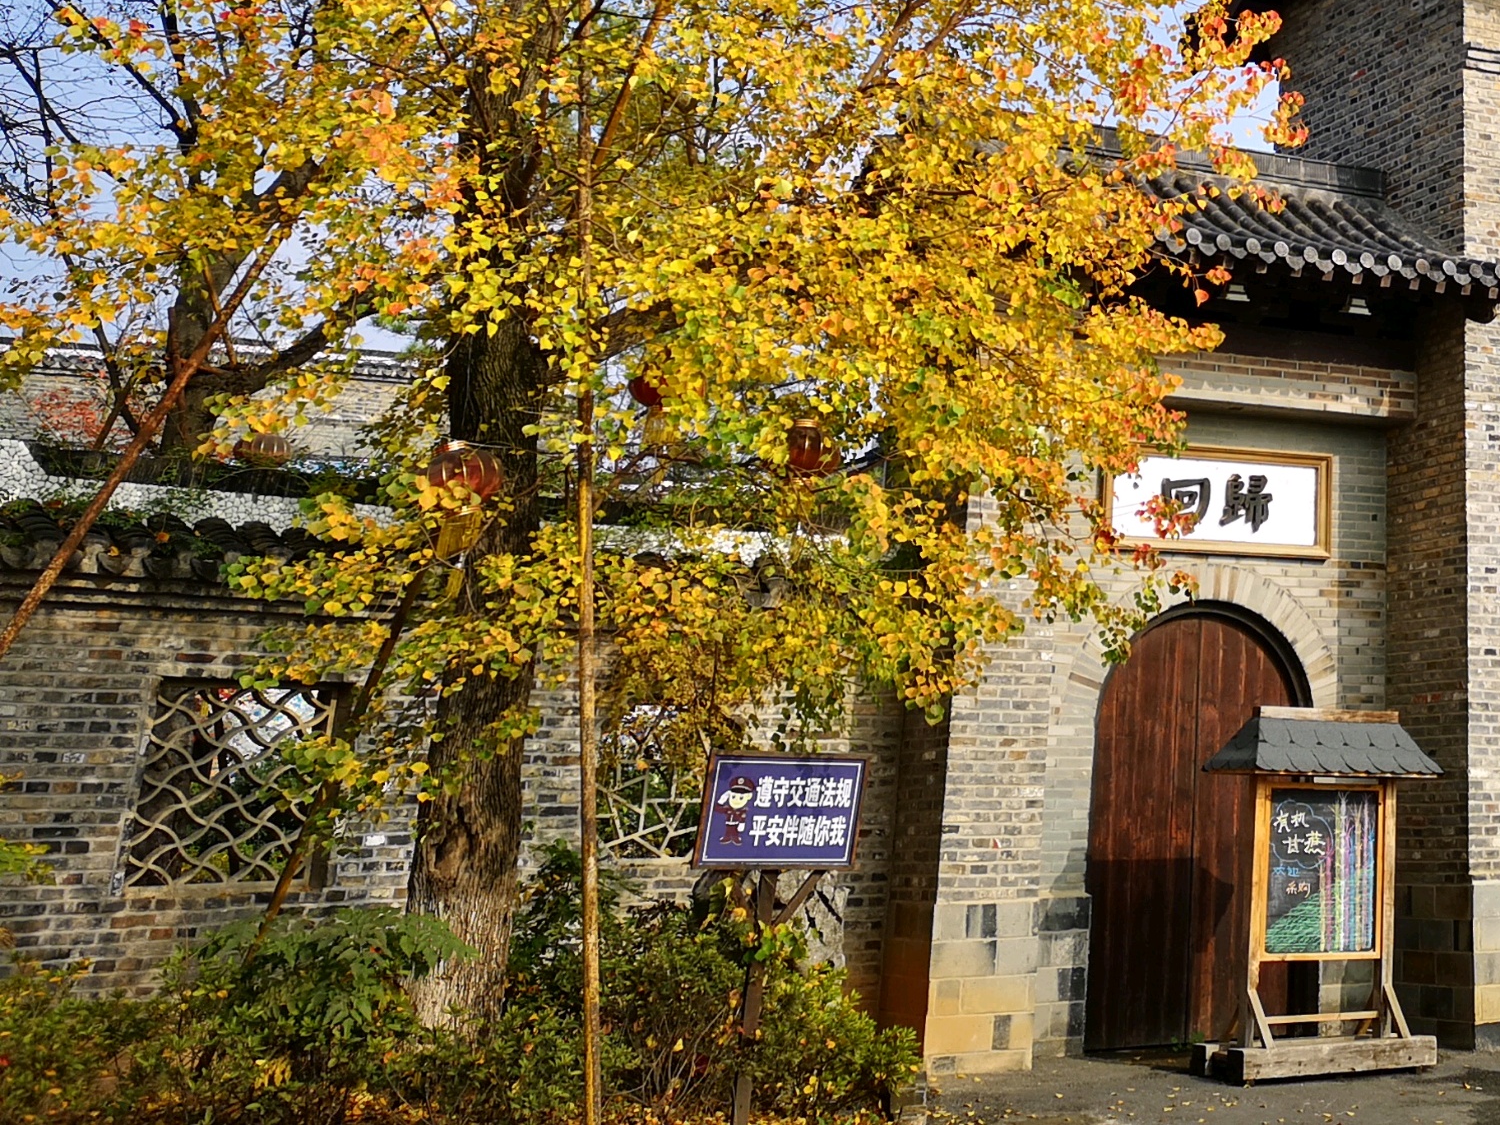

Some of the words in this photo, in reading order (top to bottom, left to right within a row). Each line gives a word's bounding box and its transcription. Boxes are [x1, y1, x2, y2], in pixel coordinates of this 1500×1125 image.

[753, 775, 853, 808] 遵守交通法规
[749, 815, 847, 847] 平安伴随你我
[1272, 809, 1310, 833] 有机
[1281, 830, 1326, 856] 甘蔗
[1272, 863, 1301, 878] 欢迎
[1285, 880, 1311, 898] 采购
